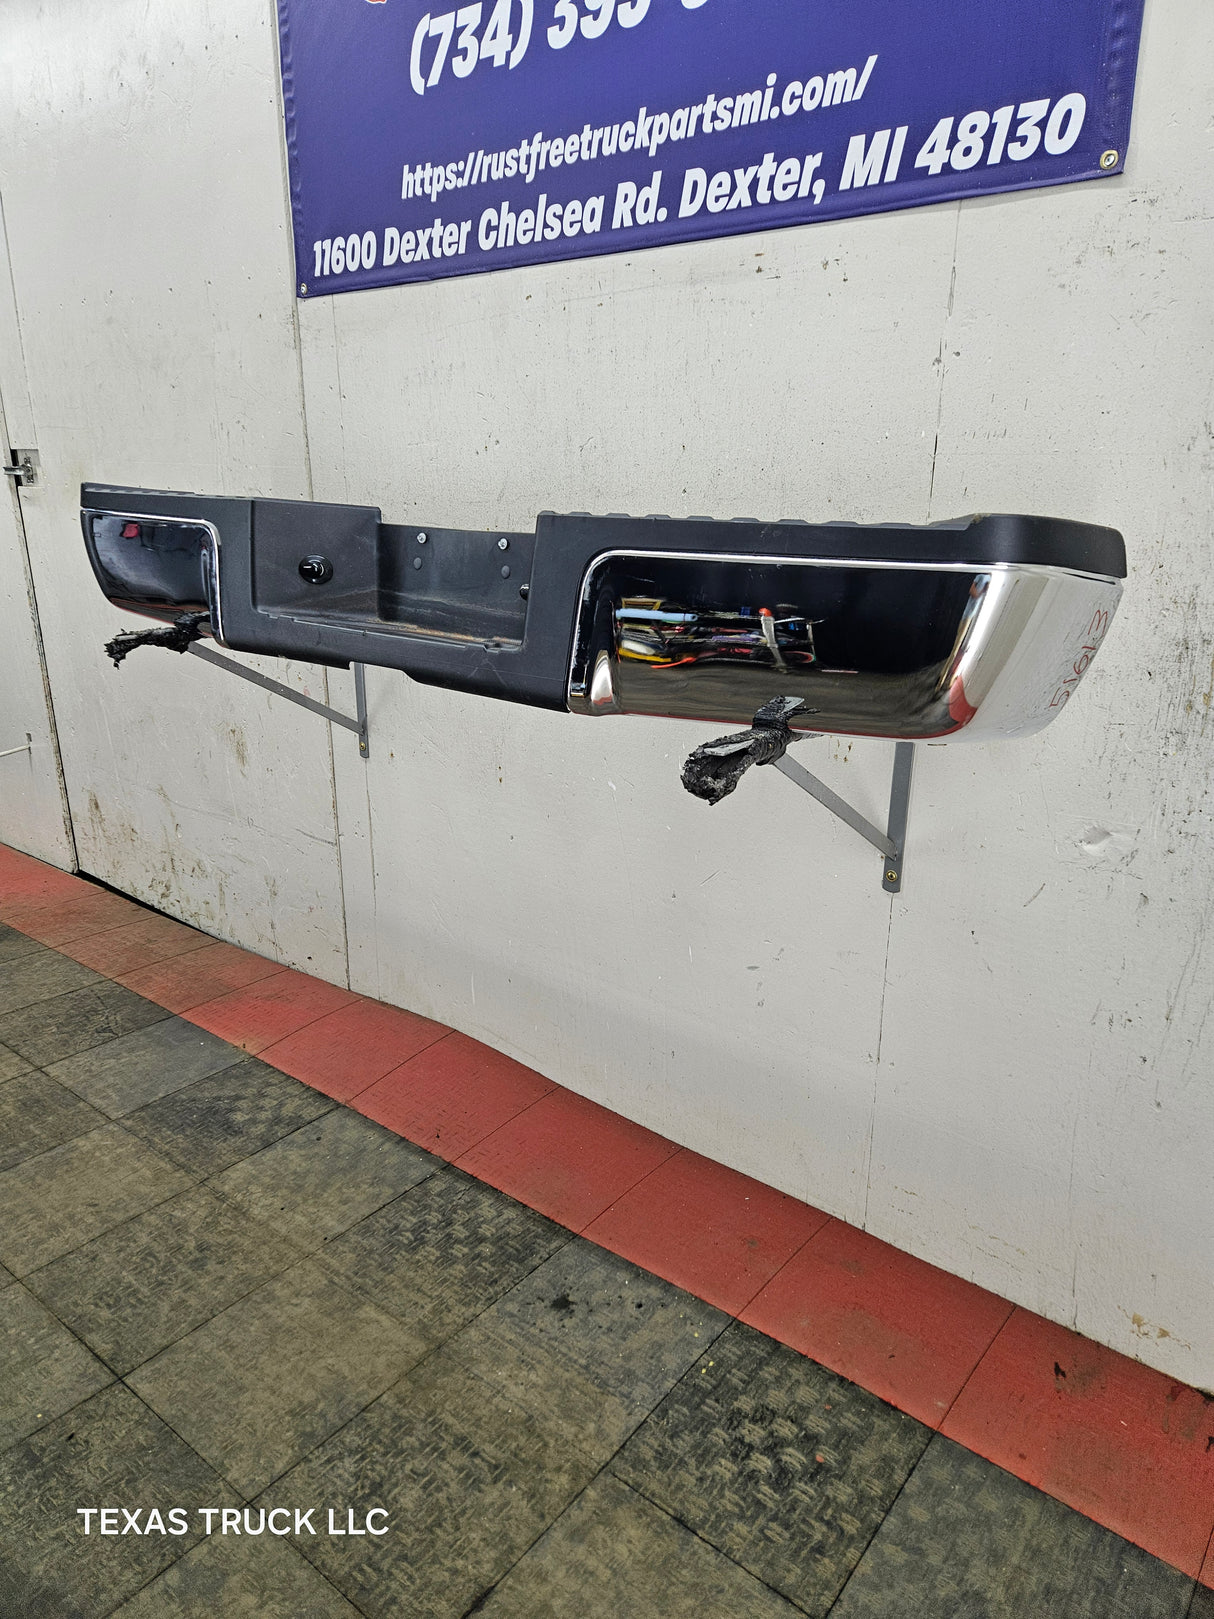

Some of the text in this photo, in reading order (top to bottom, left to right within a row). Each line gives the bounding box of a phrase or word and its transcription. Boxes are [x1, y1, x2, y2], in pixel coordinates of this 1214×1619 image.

[409, 0, 534, 96] (734)
[313, 92, 1087, 278] 11600 Dexter Chelsea Rd. Dexter, MI 48130
[401, 54, 879, 203] https://rustfreetruckpartsmi.com/
